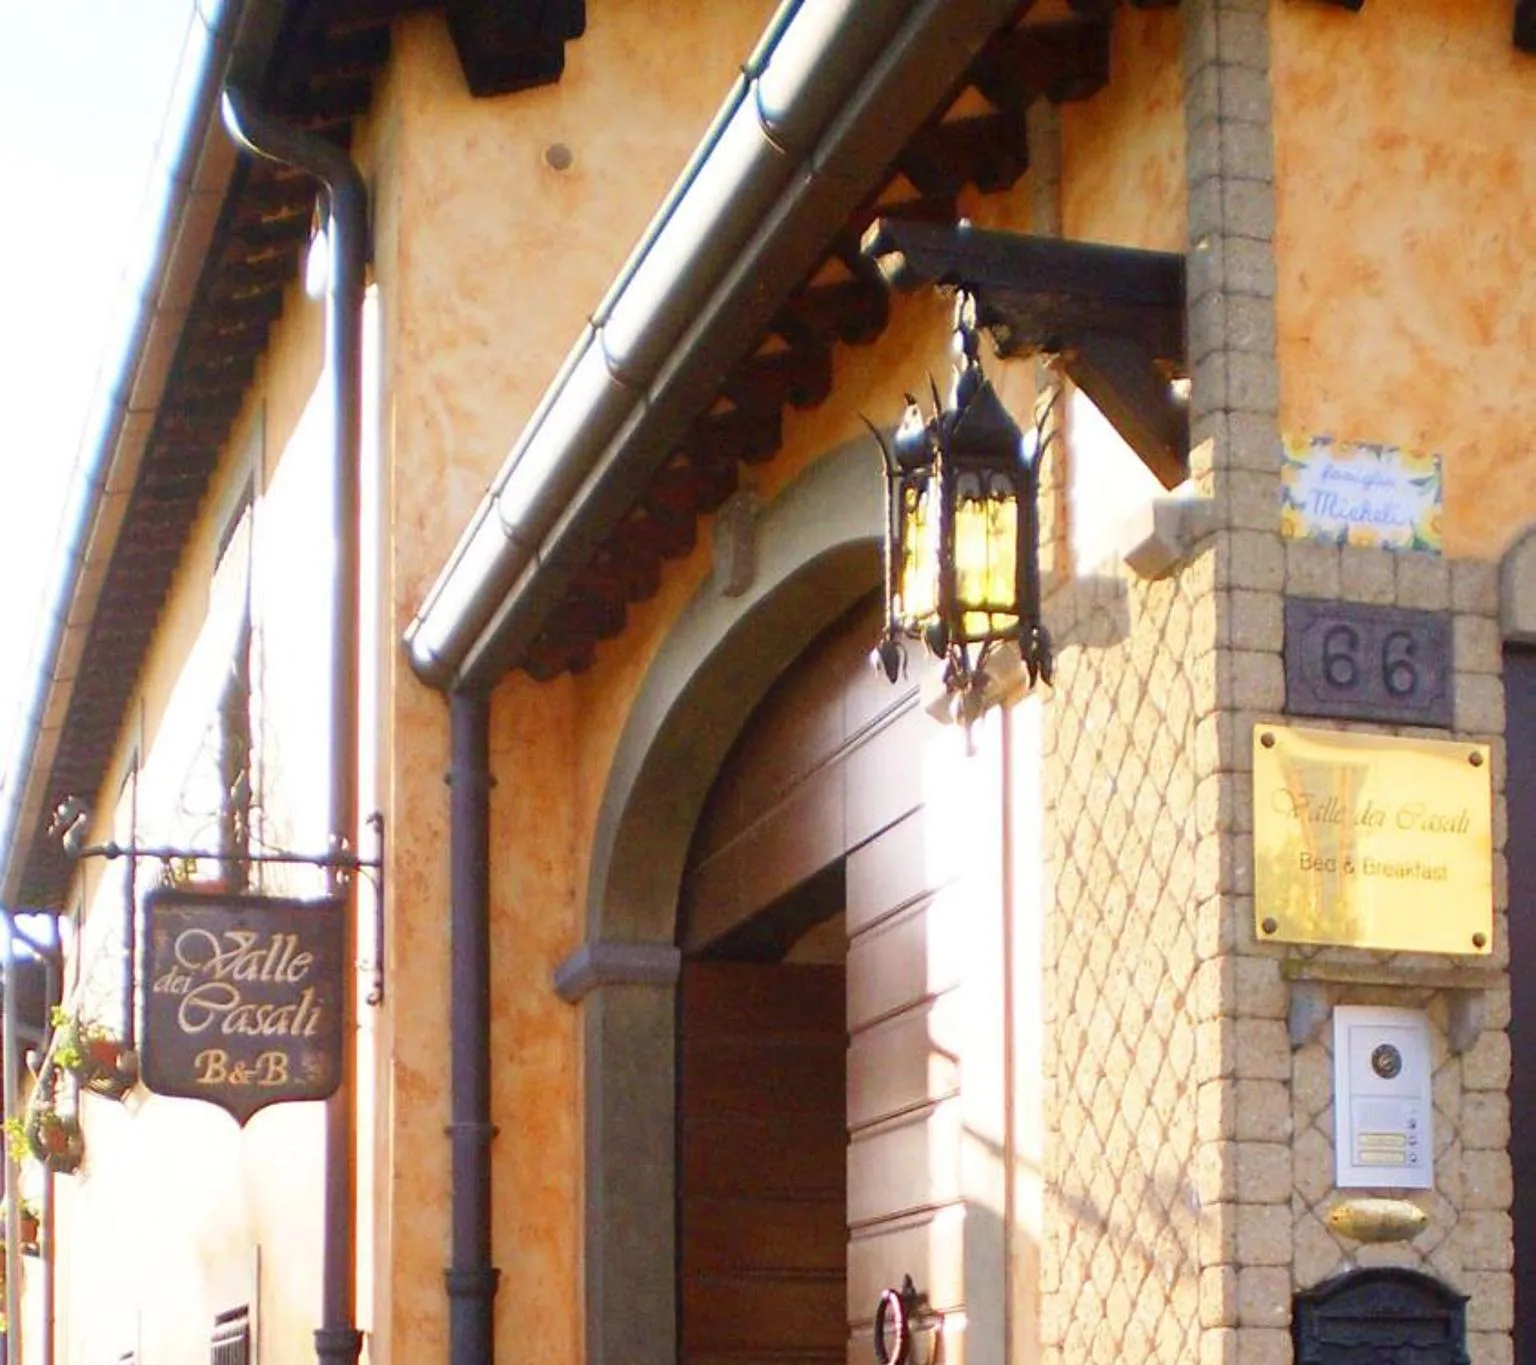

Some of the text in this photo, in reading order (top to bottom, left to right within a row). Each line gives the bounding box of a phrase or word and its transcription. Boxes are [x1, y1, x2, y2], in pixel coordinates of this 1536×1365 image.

[1322, 623, 1419, 697] 66
[1395, 801, 1471, 835] Casali
[1299, 851, 1448, 882] Bed & Breakfast
[174, 928, 315, 983] Valle
[153, 965, 325, 1037] dei Casali
[194, 1048, 289, 1086] B&B
